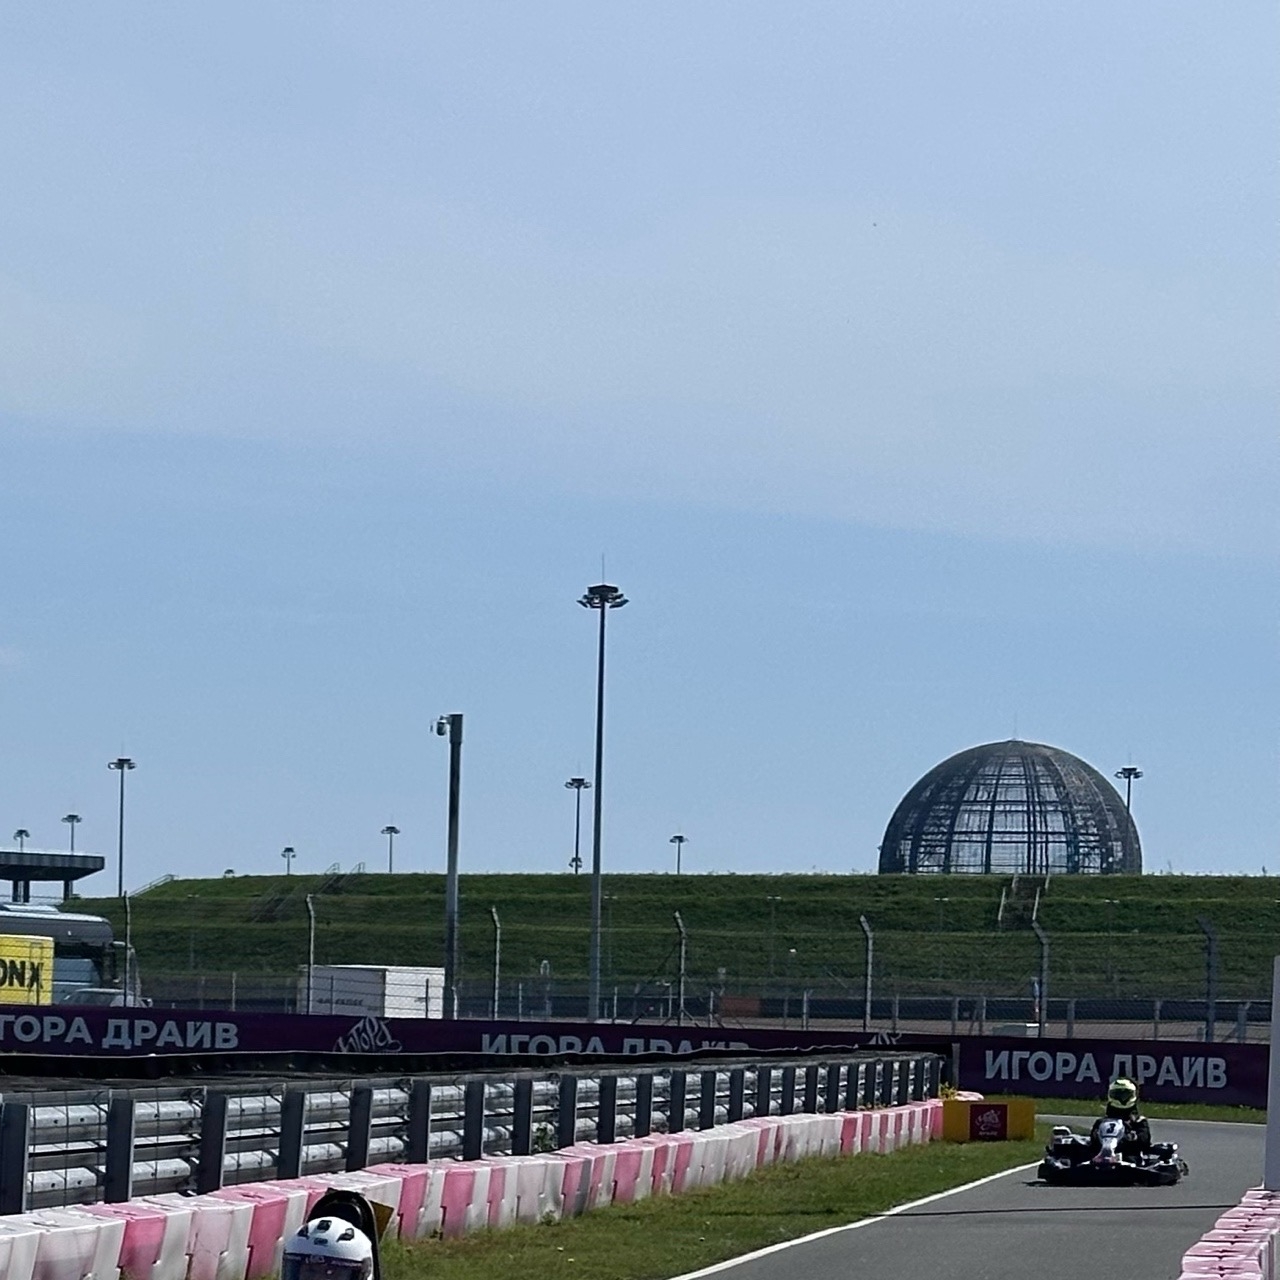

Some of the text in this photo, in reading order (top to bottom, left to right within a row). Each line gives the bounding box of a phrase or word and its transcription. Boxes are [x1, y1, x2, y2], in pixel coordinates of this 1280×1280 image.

[101, 1018, 239, 1050] ДРАЙВ
[984, 1050, 1228, 1089] ИГОРА ДРАЙВ
